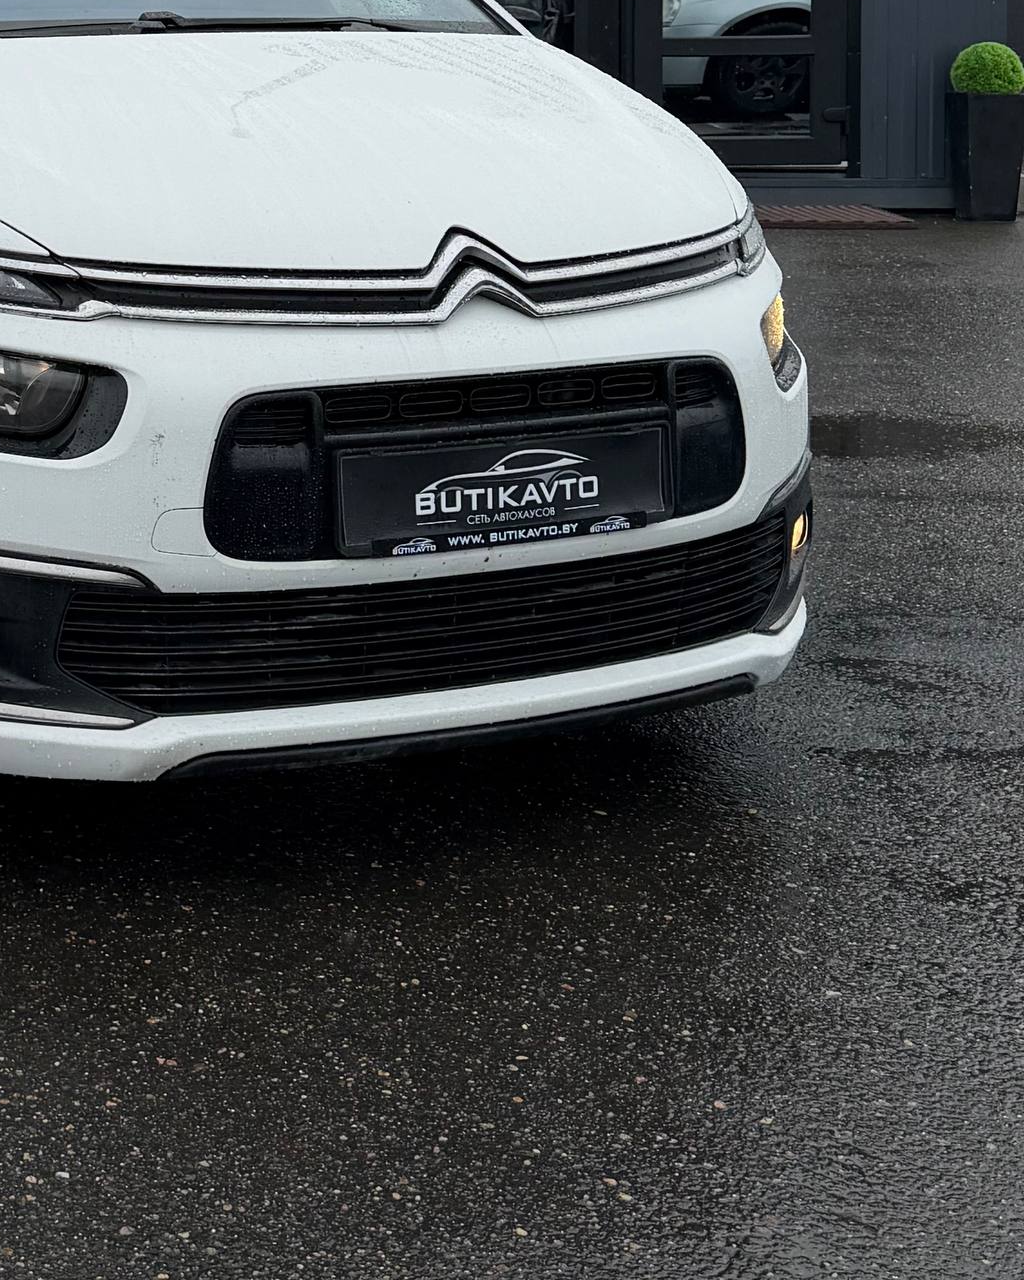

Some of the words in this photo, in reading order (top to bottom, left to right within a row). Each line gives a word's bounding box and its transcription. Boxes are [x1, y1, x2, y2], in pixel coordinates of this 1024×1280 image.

[415, 474, 600, 517] BUTIKAVTO
[466, 512, 491, 526] СЕТЬ
[492, 505, 556, 523] АВТОХАУСОВ
[489, 522, 578, 543] BUTIKAVTO.BY
[589, 522, 630, 534] BUTIKAVTO
[392, 544, 437, 556] BUTIKAVTO
